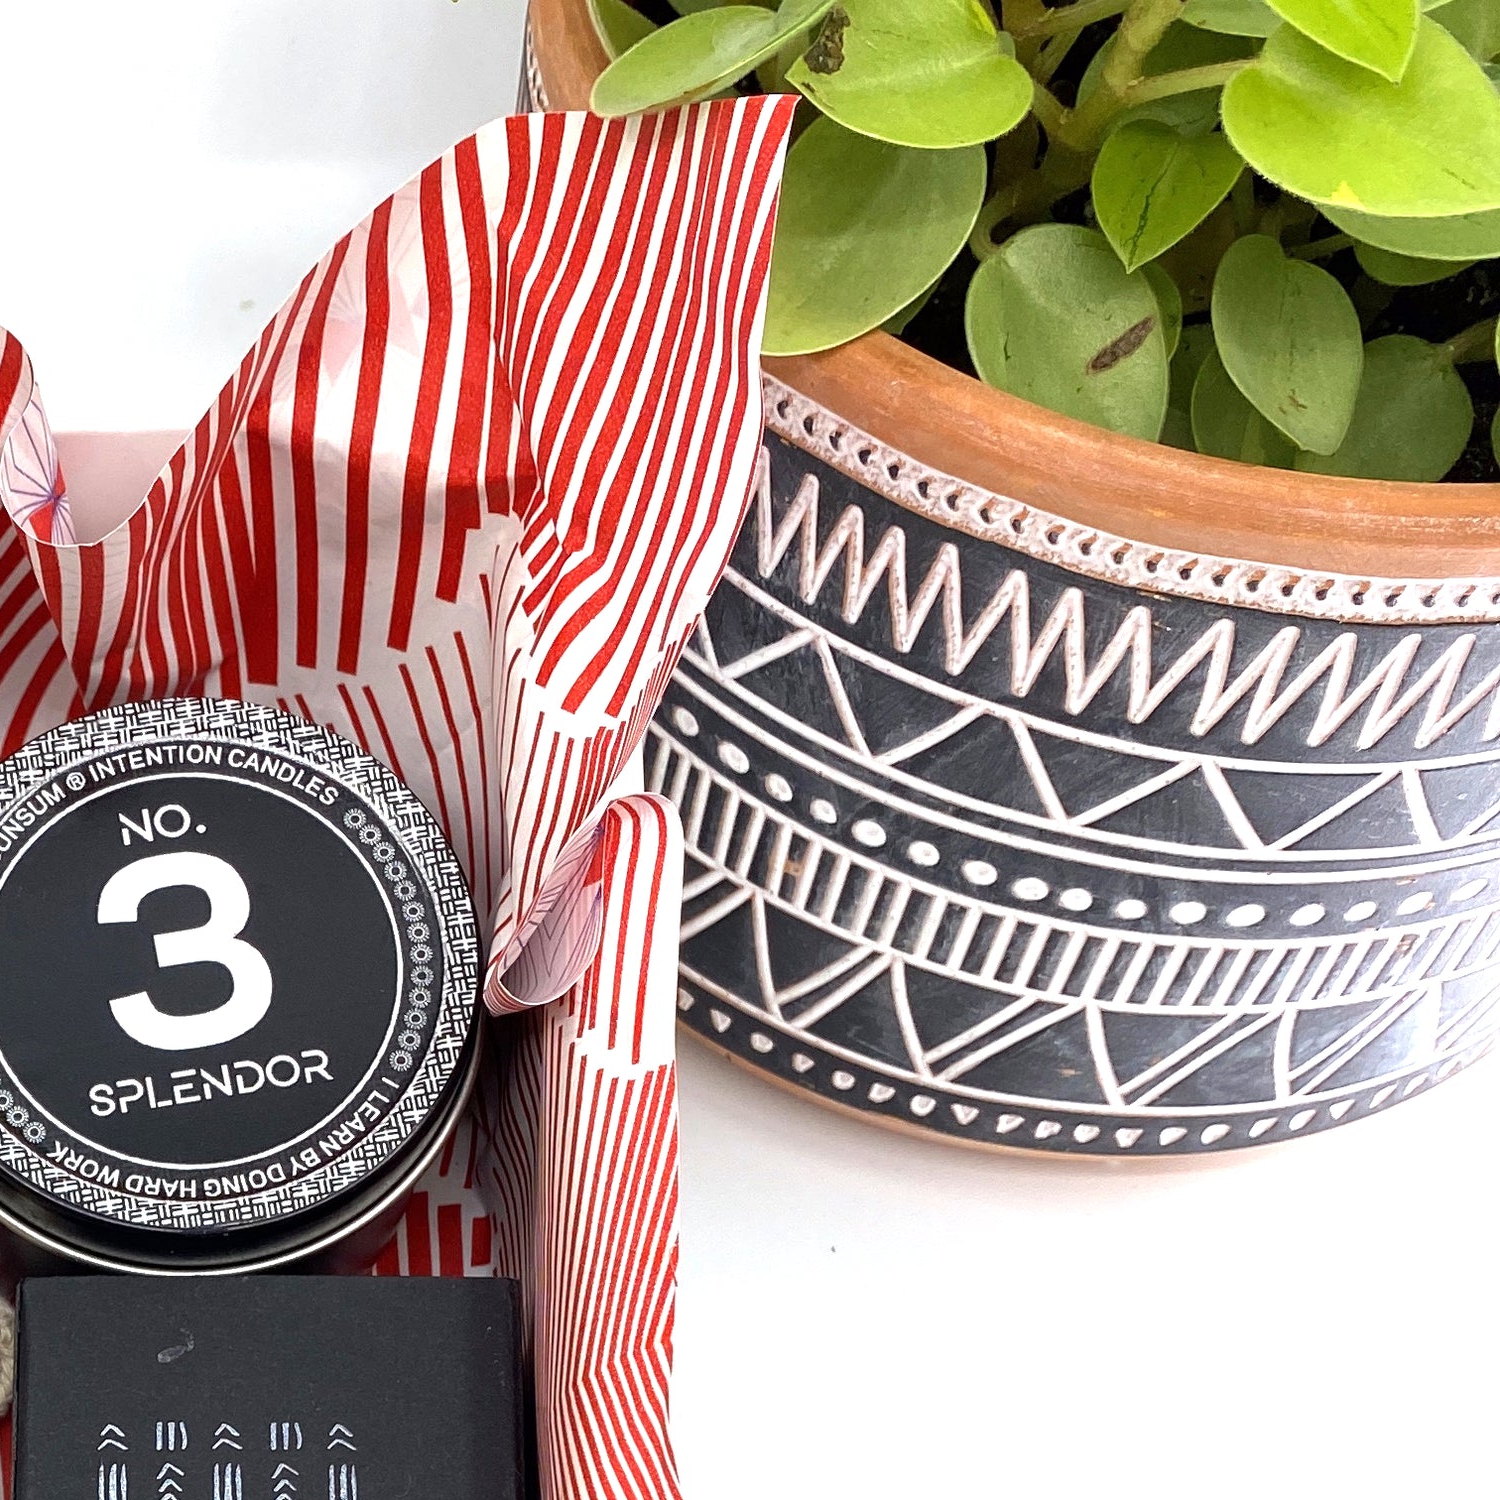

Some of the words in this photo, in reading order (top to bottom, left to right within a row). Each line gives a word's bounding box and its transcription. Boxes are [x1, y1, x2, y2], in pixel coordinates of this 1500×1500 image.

[89, 744, 221, 783] INTENTION
[227, 746, 340, 806] CANDLES
[117, 803, 208, 846] NO.
[96, 850, 274, 1052] 3
[87, 1048, 335, 1118] SPLENDOR
[319, 1089, 391, 1155] LEARN
[47, 1140, 120, 1187] WORK
[126, 1173, 197, 1199] HARD
[203, 1167, 287, 1197] DOING
[291, 1148, 317, 1178] BY
